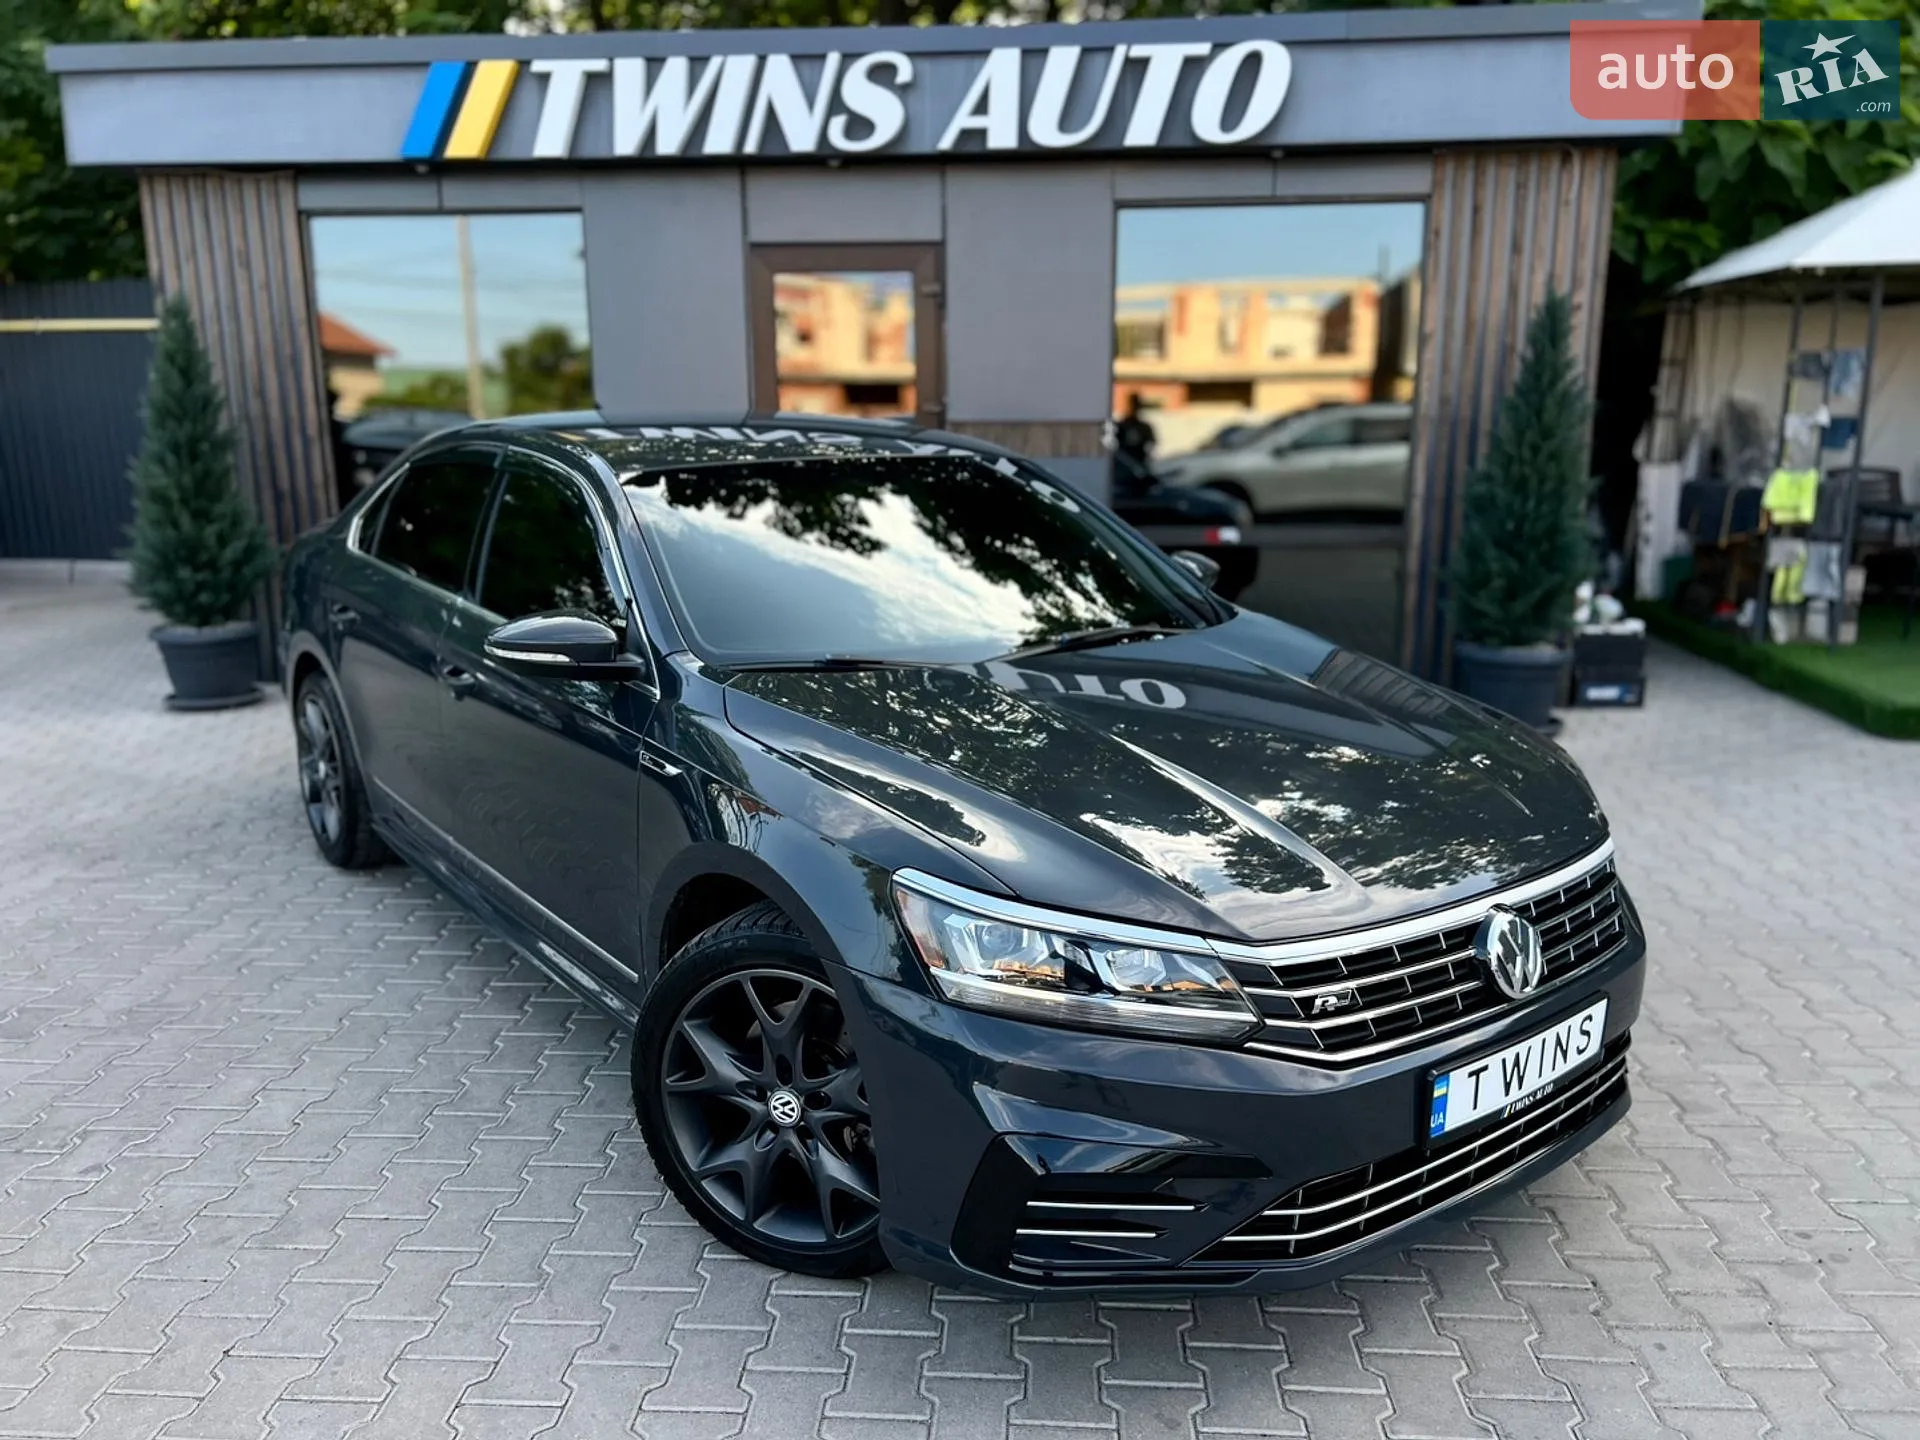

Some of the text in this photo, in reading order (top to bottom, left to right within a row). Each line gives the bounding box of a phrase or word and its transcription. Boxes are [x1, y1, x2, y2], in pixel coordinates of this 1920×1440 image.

[530, 39, 1293, 159] TWINS AUTO
[1467, 1014, 1595, 1110] TWINS
[1430, 1112, 1444, 1128] UA
